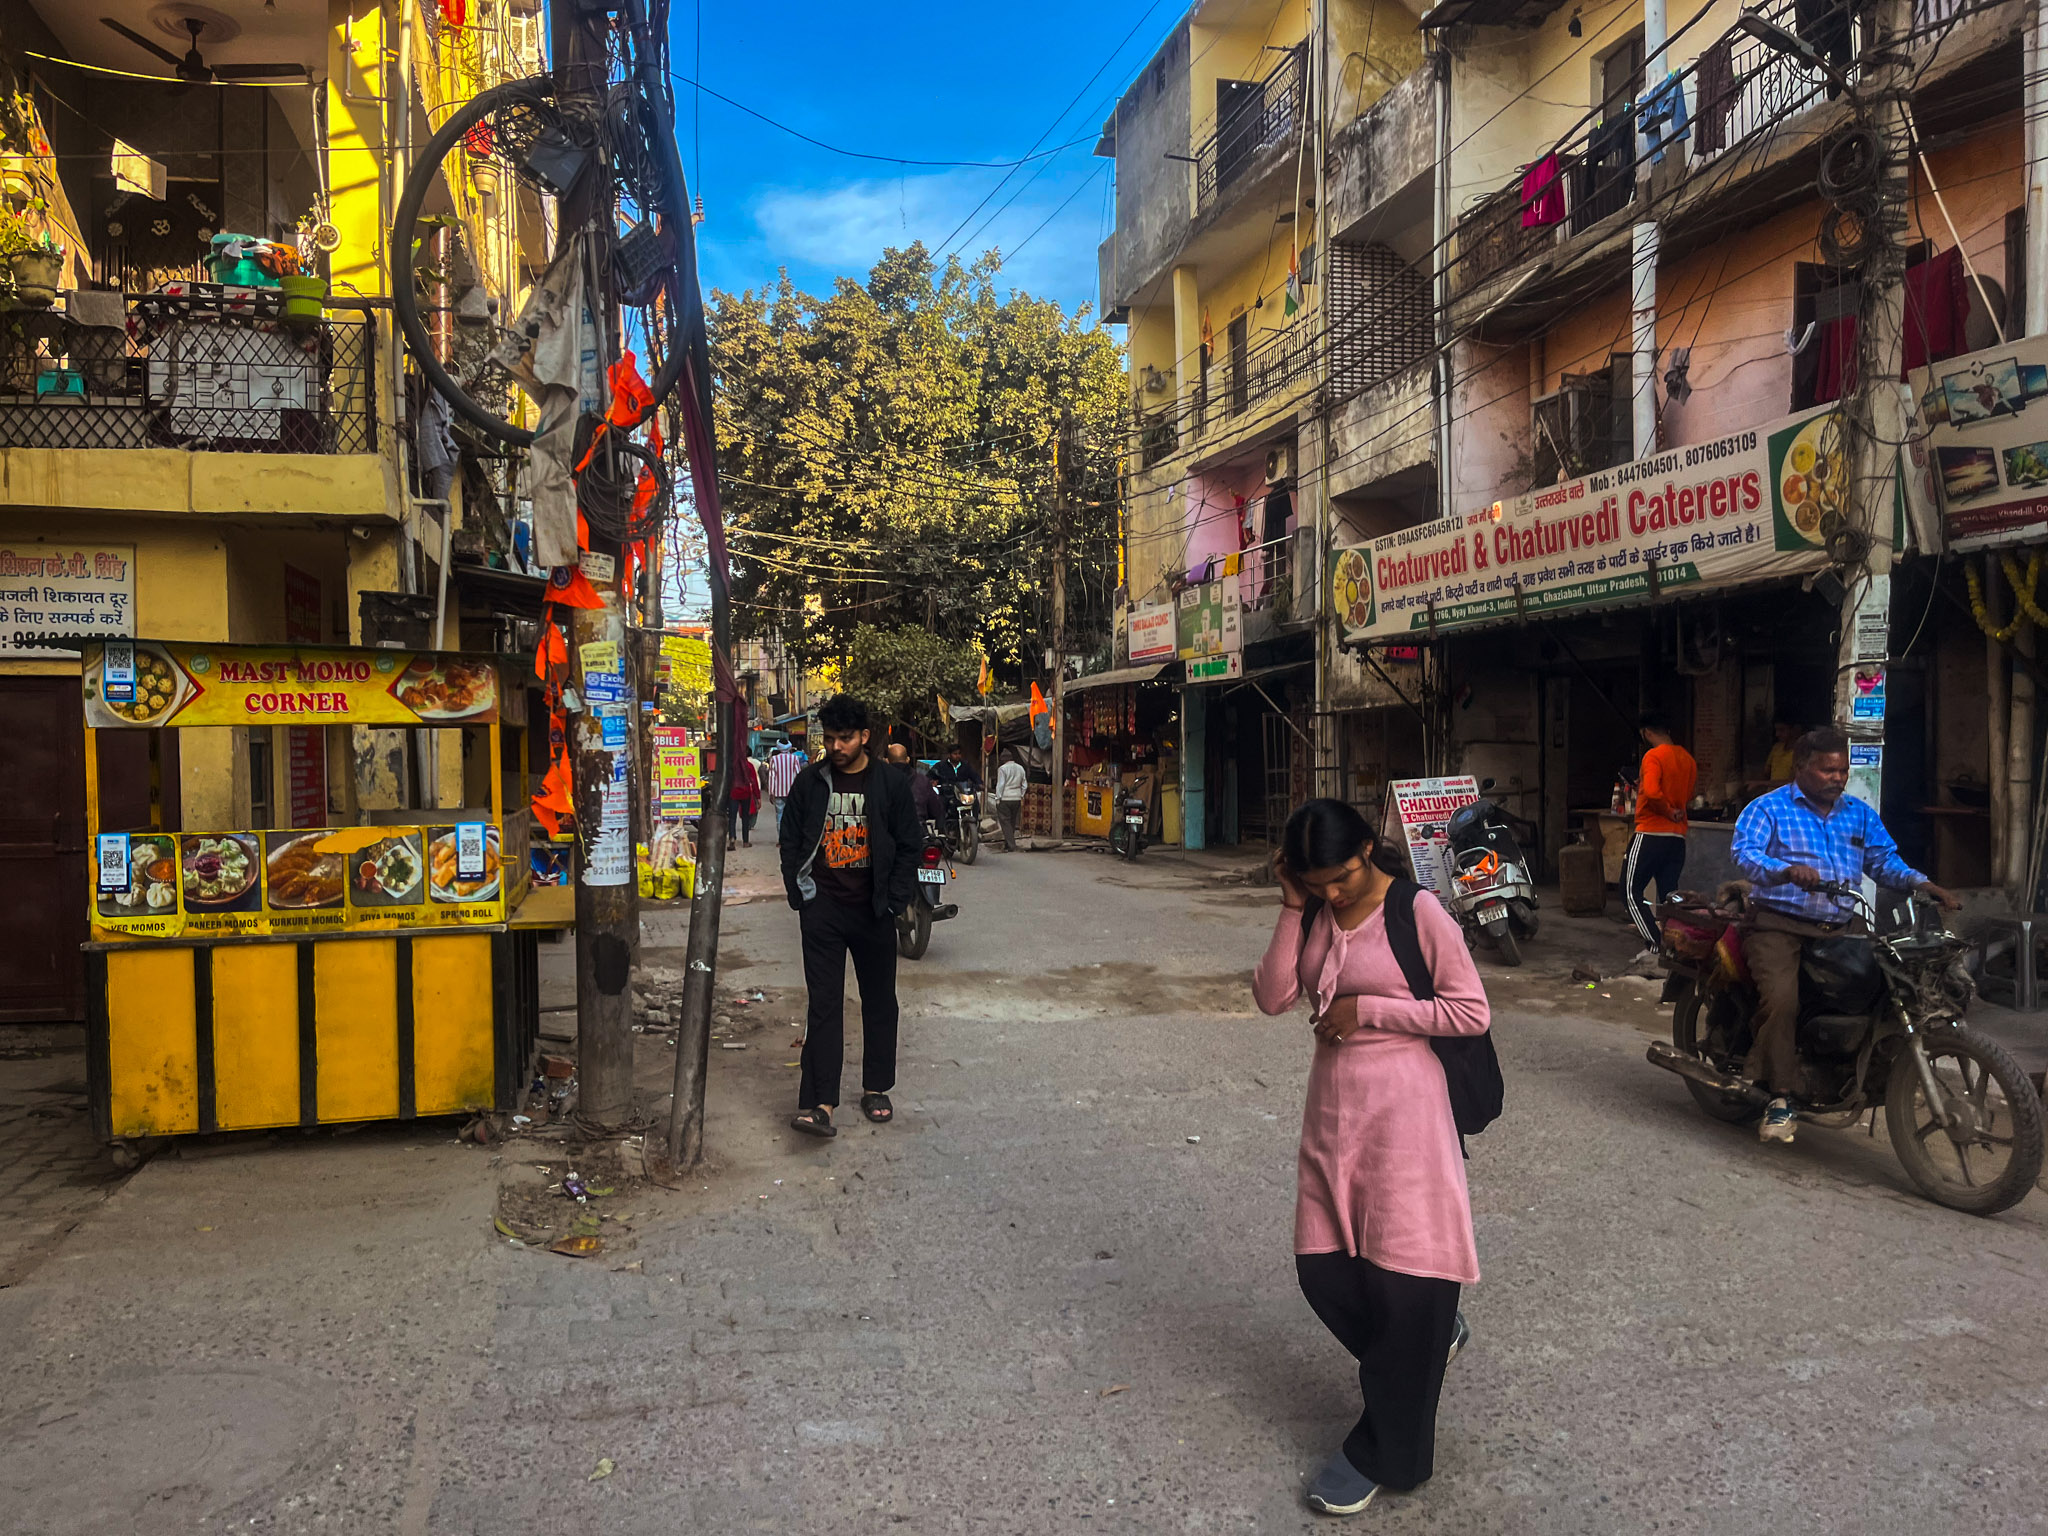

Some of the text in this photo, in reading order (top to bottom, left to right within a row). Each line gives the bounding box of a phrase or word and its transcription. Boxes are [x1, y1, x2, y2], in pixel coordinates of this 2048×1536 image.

[1590, 474, 1610, 494] Mob
[1618, 454, 1683, 485] 8447604501,
[1686, 432, 1757, 466] 8076063109
[1568, 480, 1584, 500] वाले
[1377, 472, 1762, 590] Chaturvedi & Chaturvedi Caterers
[1375, 537, 1396, 552] GSTIN:
[1487, 576, 1502, 592] शादी
[1538, 566, 1556, 584] प्रवेश
[1558, 560, 1574, 579] सभी
[1577, 560, 1594, 575] तरह
[1597, 554, 1606, 571] के
[1609, 548, 1627, 568] पार्टी
[1629, 547, 1640, 564] के
[1670, 541, 1688, 562] बुक
[1691, 530, 1715, 552] किये
[1717, 525, 1742, 546] जाते
[44, 586, 104, 604] शिकायत
[110, 592, 128, 608] दूर
[1418, 614, 1429, 624] H.N
[1468, 601, 1496, 614] Khand-3,
[1498, 596, 1542, 610] Indiraram,
[1544, 586, 1585, 602] Ghaziabad,
[1587, 583, 1607, 596] Uttar
[1610, 574, 1648, 591] Pradesh,
[1656, 566, 1686, 582] 01014
[14, 607, 43, 624] लिए
[48, 608, 95, 624] सम्पर्क
[100, 609, 123, 625] करें
[218, 660, 372, 682] MAST MOMO
[244, 692, 349, 714] CORNER
[655, 736, 679, 746] OBILE
[664, 752, 696, 766] मसाले
[664, 774, 696, 788] मसाले
[828, 792, 865, 815] OKY
[1400, 794, 1479, 812] CHATURVEDI
[1411, 812, 1450, 821] Chaturvedi
[269, 914, 344, 927] KURKURE MOMOS
[473, 909, 493, 917] ROLL
[131, 922, 166, 932] MOMOS
[224, 919, 258, 929] MOMOS
